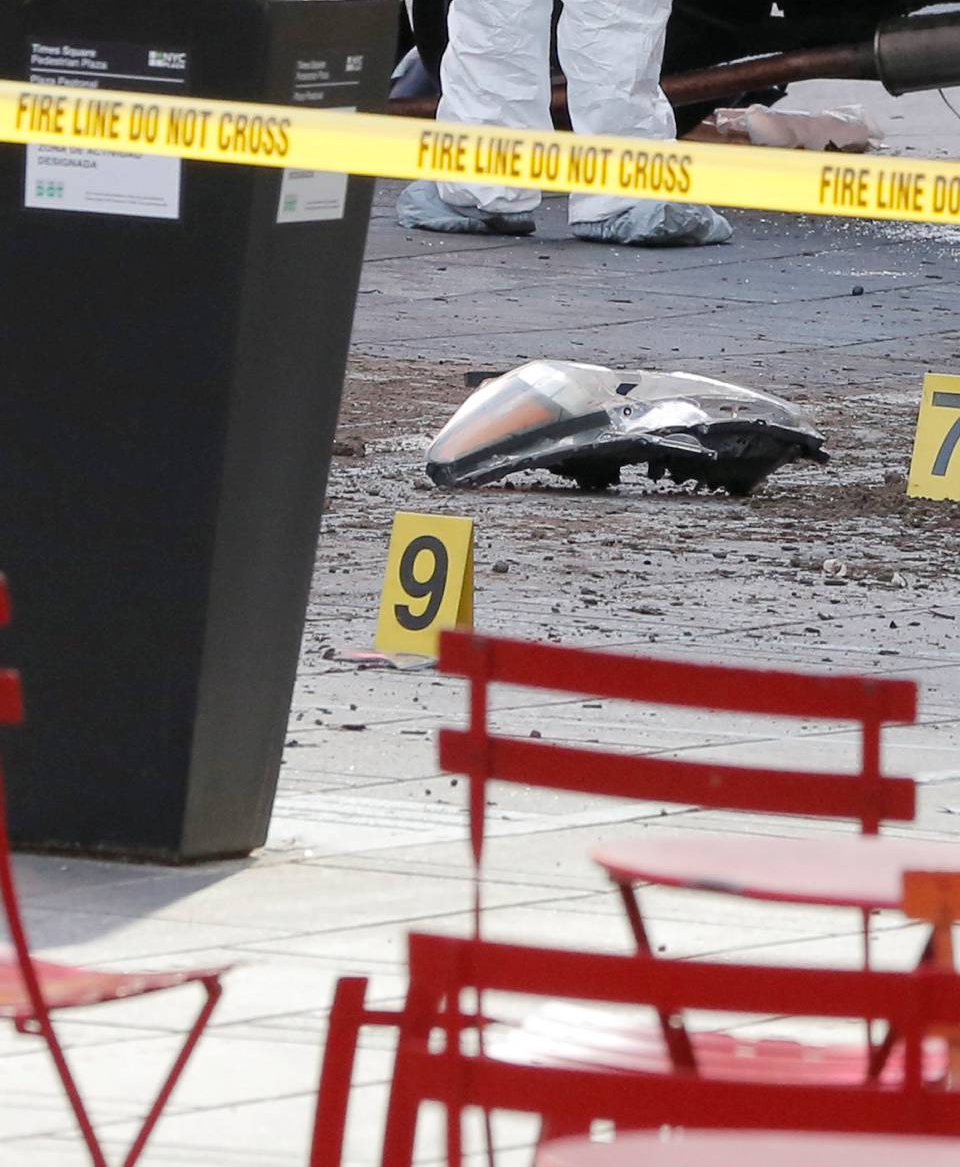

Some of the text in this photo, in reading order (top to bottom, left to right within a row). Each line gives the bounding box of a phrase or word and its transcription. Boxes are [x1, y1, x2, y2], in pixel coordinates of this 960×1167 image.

[32, 43, 96, 59] Times Square
[80, 58, 108, 70] Plaza
[15, 93, 292, 157] FIRE LINE DO NOT CROSS
[37, 156, 97, 169] DESIGNADA
[417, 131, 693, 194] FIRE LINE DO NOT CROSS
[819, 166, 870, 207] FIRE
[877, 170, 925, 211] LINE
[933, 175, 960, 214] DO
[394, 535, 449, 631] 9
